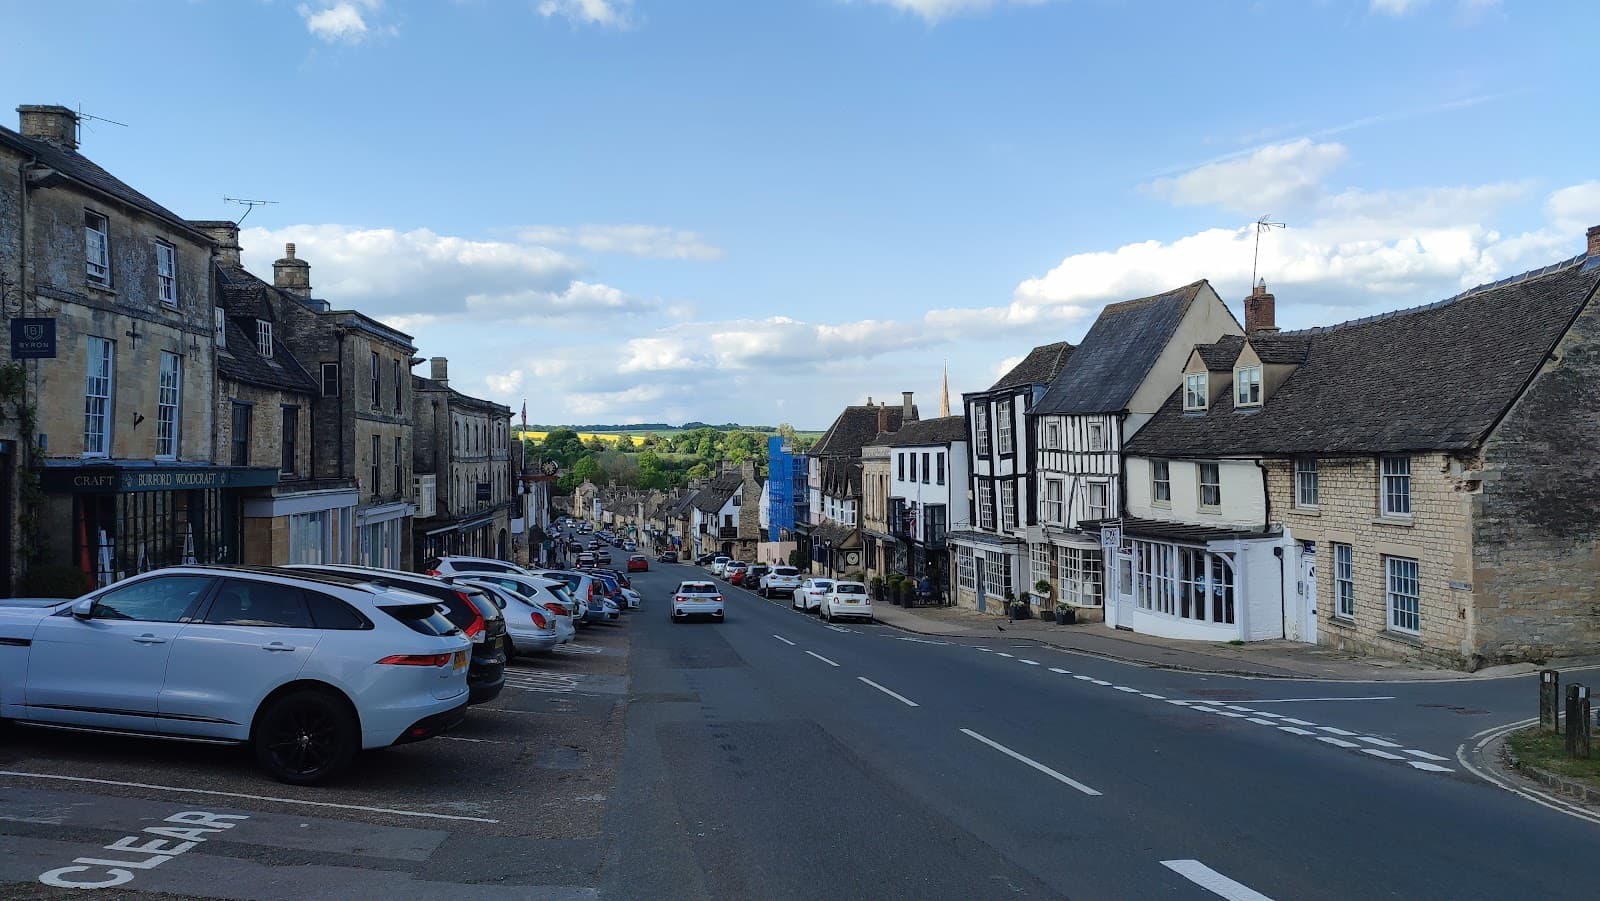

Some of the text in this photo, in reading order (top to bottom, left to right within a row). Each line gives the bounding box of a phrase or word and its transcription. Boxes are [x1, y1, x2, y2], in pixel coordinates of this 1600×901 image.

[73, 475, 114, 486] CRAFT
[138, 472, 217, 486] BURFORD WOODCRAFT
[38, 810, 251, 890] CLEAR
